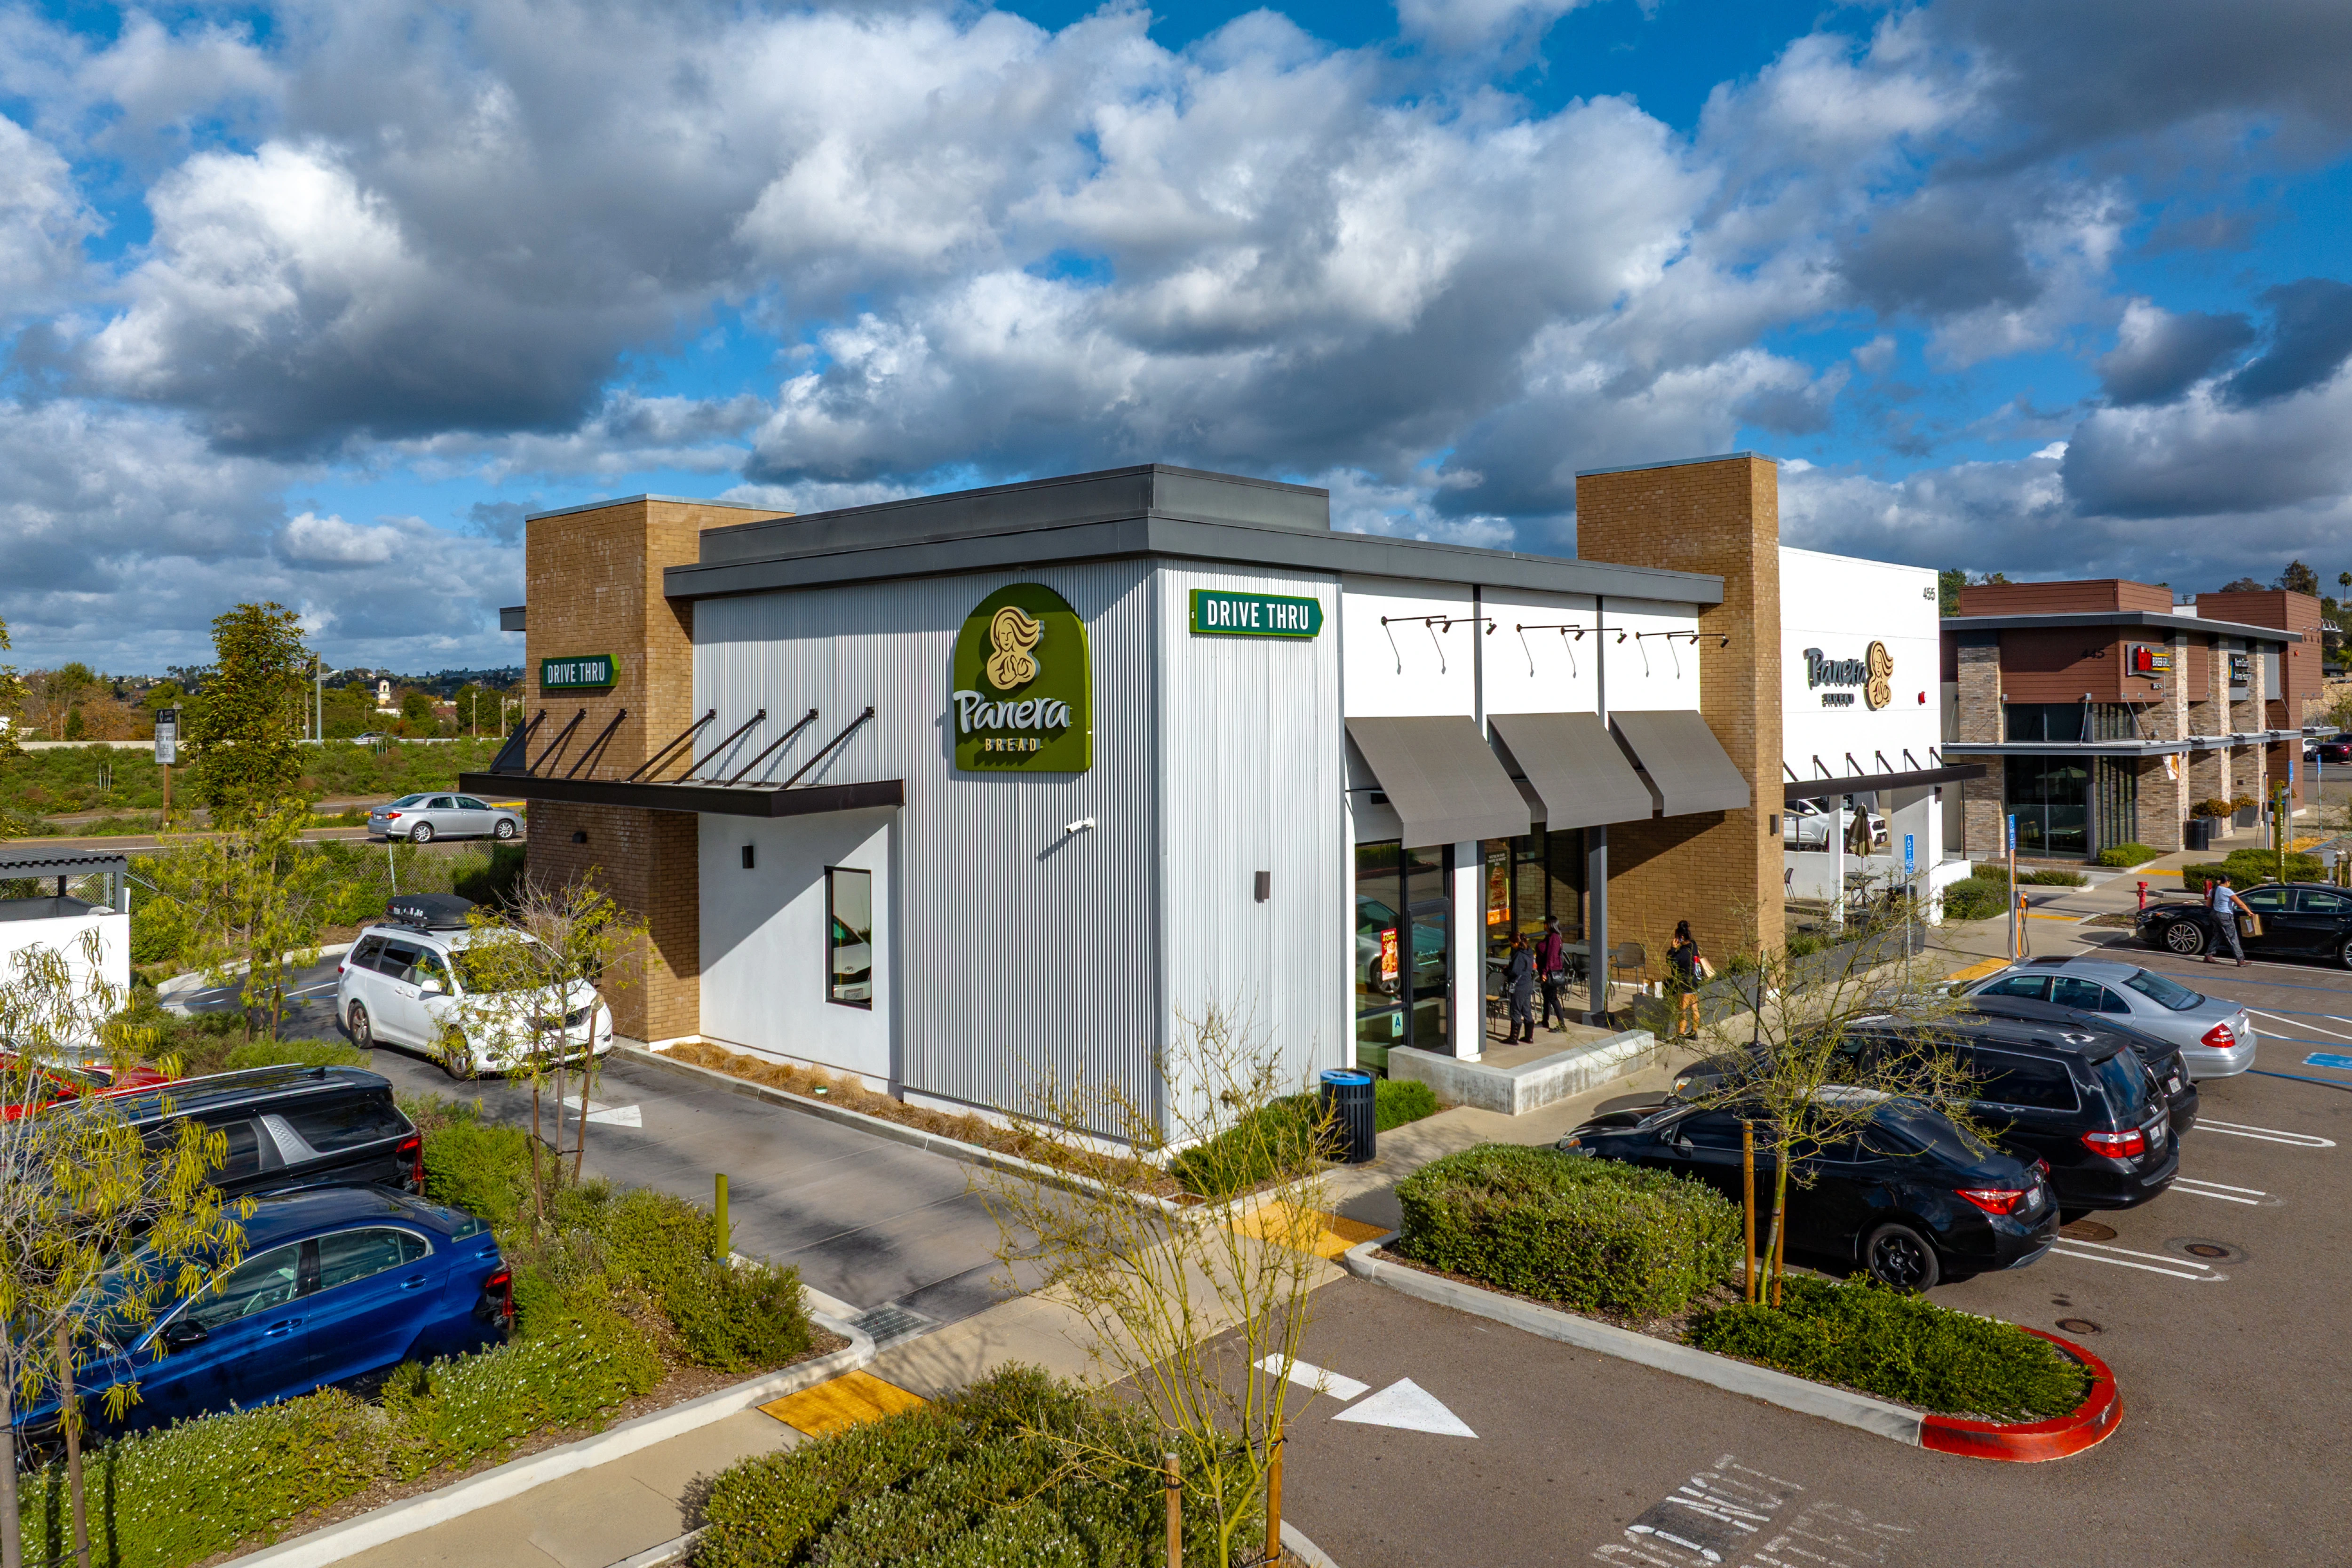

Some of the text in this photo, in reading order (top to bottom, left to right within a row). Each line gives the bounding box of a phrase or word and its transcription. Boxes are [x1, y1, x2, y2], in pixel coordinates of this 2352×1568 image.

[1923, 587, 1936, 601] 455
[1207, 599, 1309, 630] DRIVE THRU
[2081, 647, 2106, 660] 445
[548, 661, 605, 684] DRIVE THRU
[1804, 647, 1867, 688] Panera
[1826, 693, 1855, 704] BREAD
[953, 690, 1068, 734] Panera
[985, 738, 1038, 751] BREAD
[1395, 1016, 1401, 1028] A
[1666, 1453, 1804, 1532] NOT
